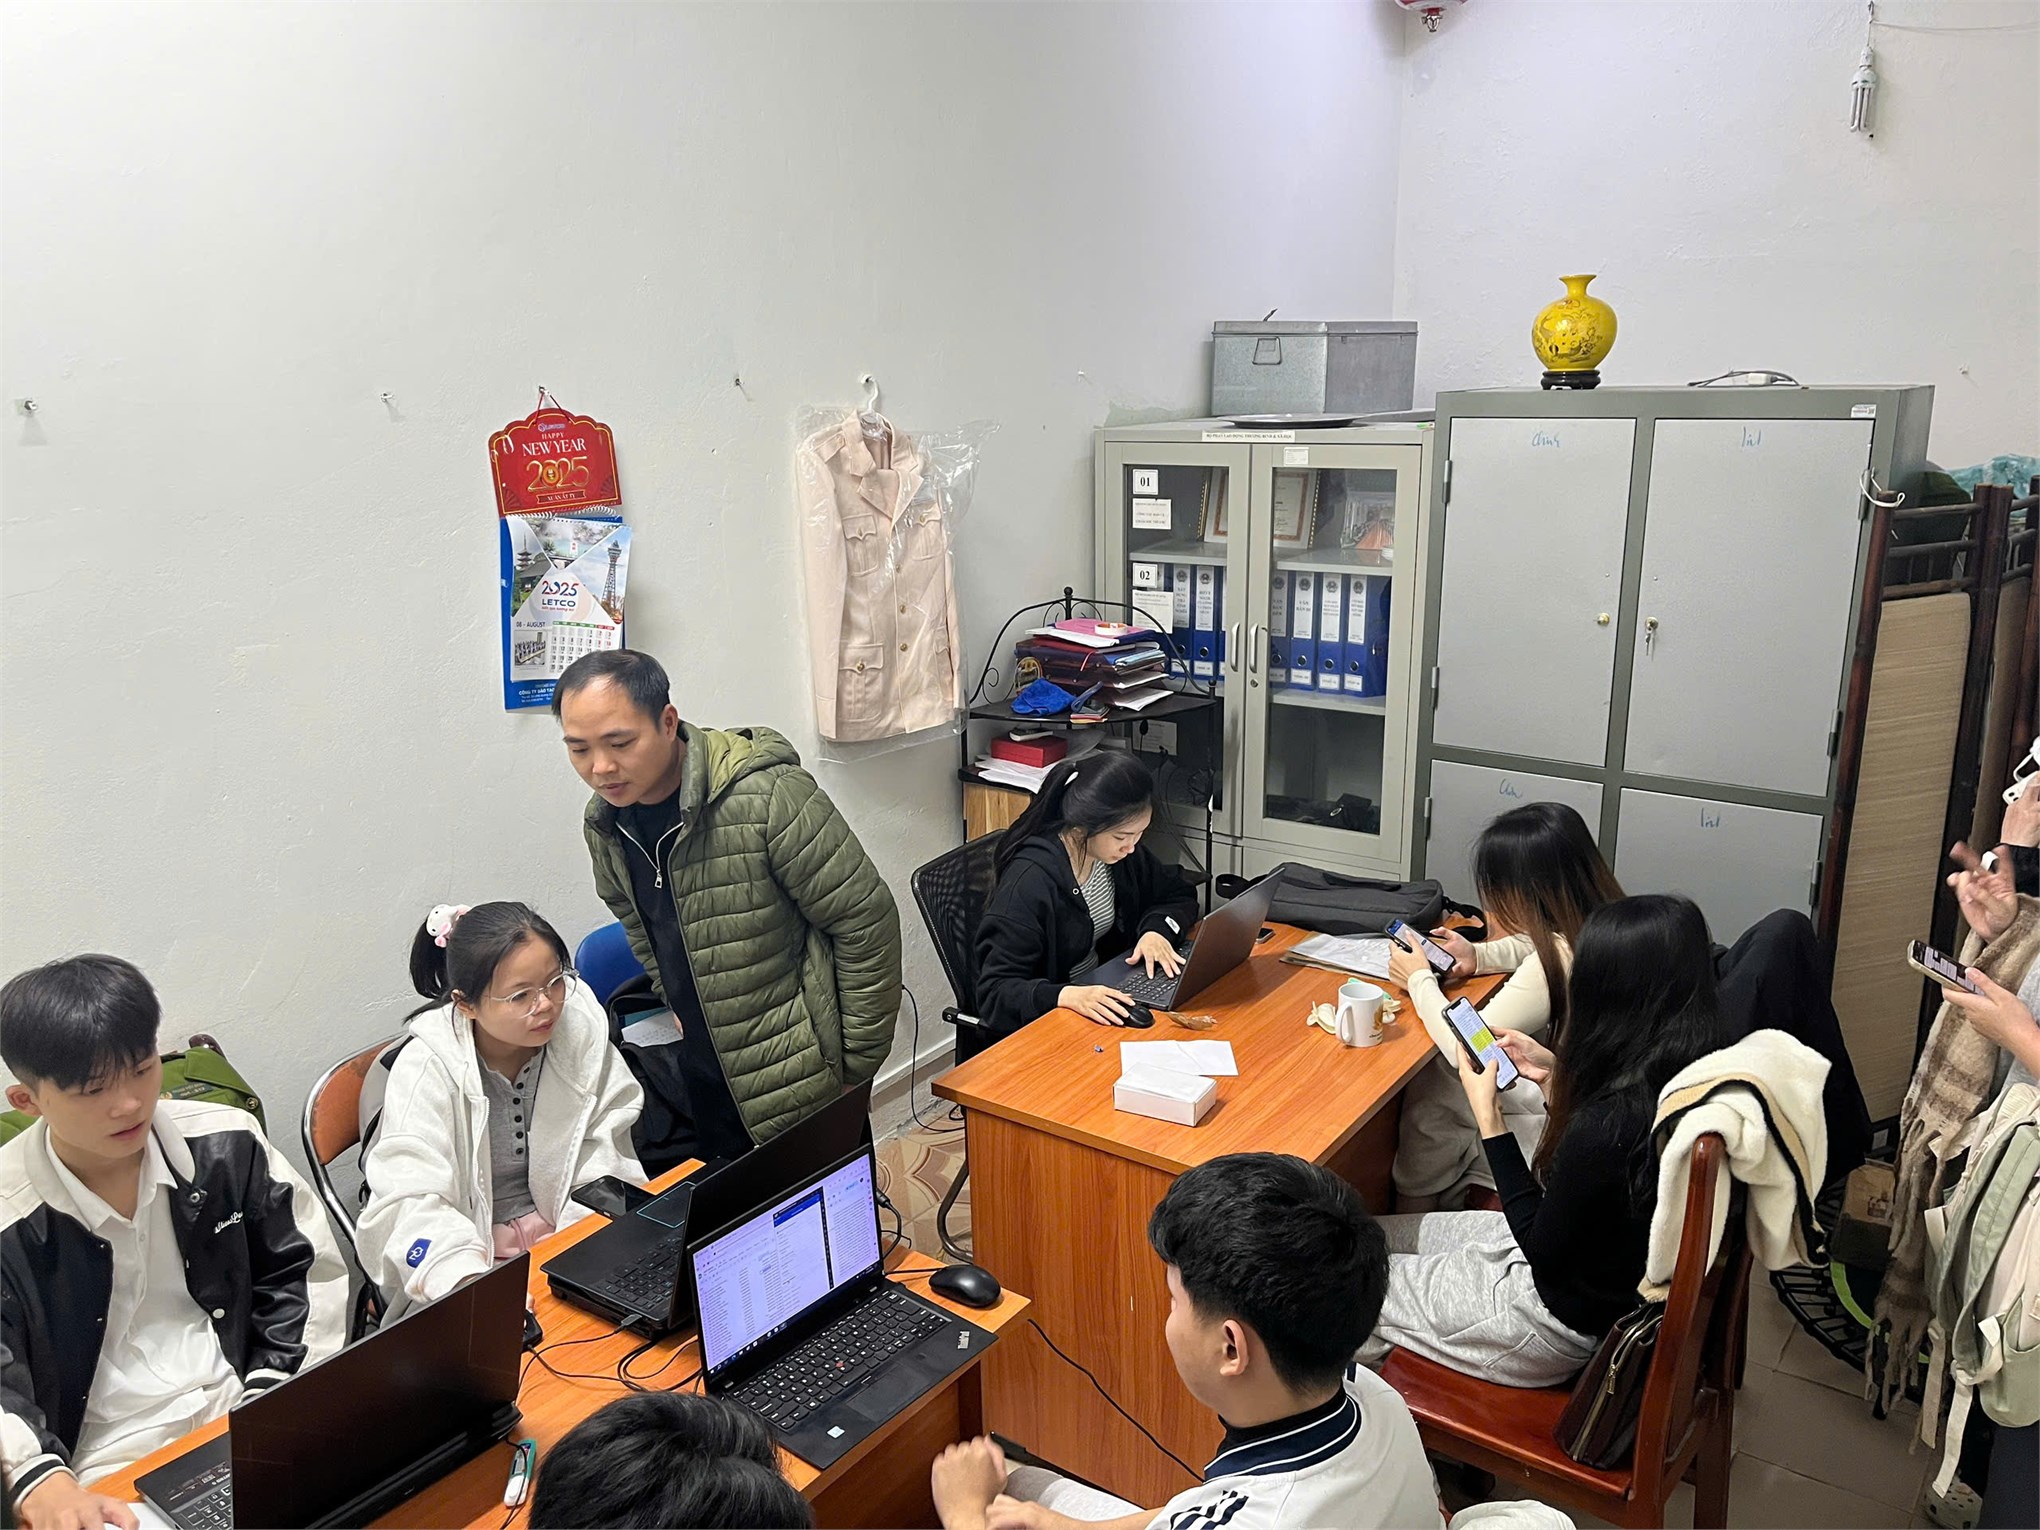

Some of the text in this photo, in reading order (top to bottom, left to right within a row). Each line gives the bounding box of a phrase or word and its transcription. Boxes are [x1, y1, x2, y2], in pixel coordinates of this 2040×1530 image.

[542, 432, 564, 440] HAPPY
[522, 438, 587, 457] NEW YEAR
[526, 456, 590, 491] 2025
[1140, 477, 1150, 486] 01
[1140, 571, 1150, 580] 02
[541, 580, 580, 596] 2025
[542, 599, 576, 607] LETCO
